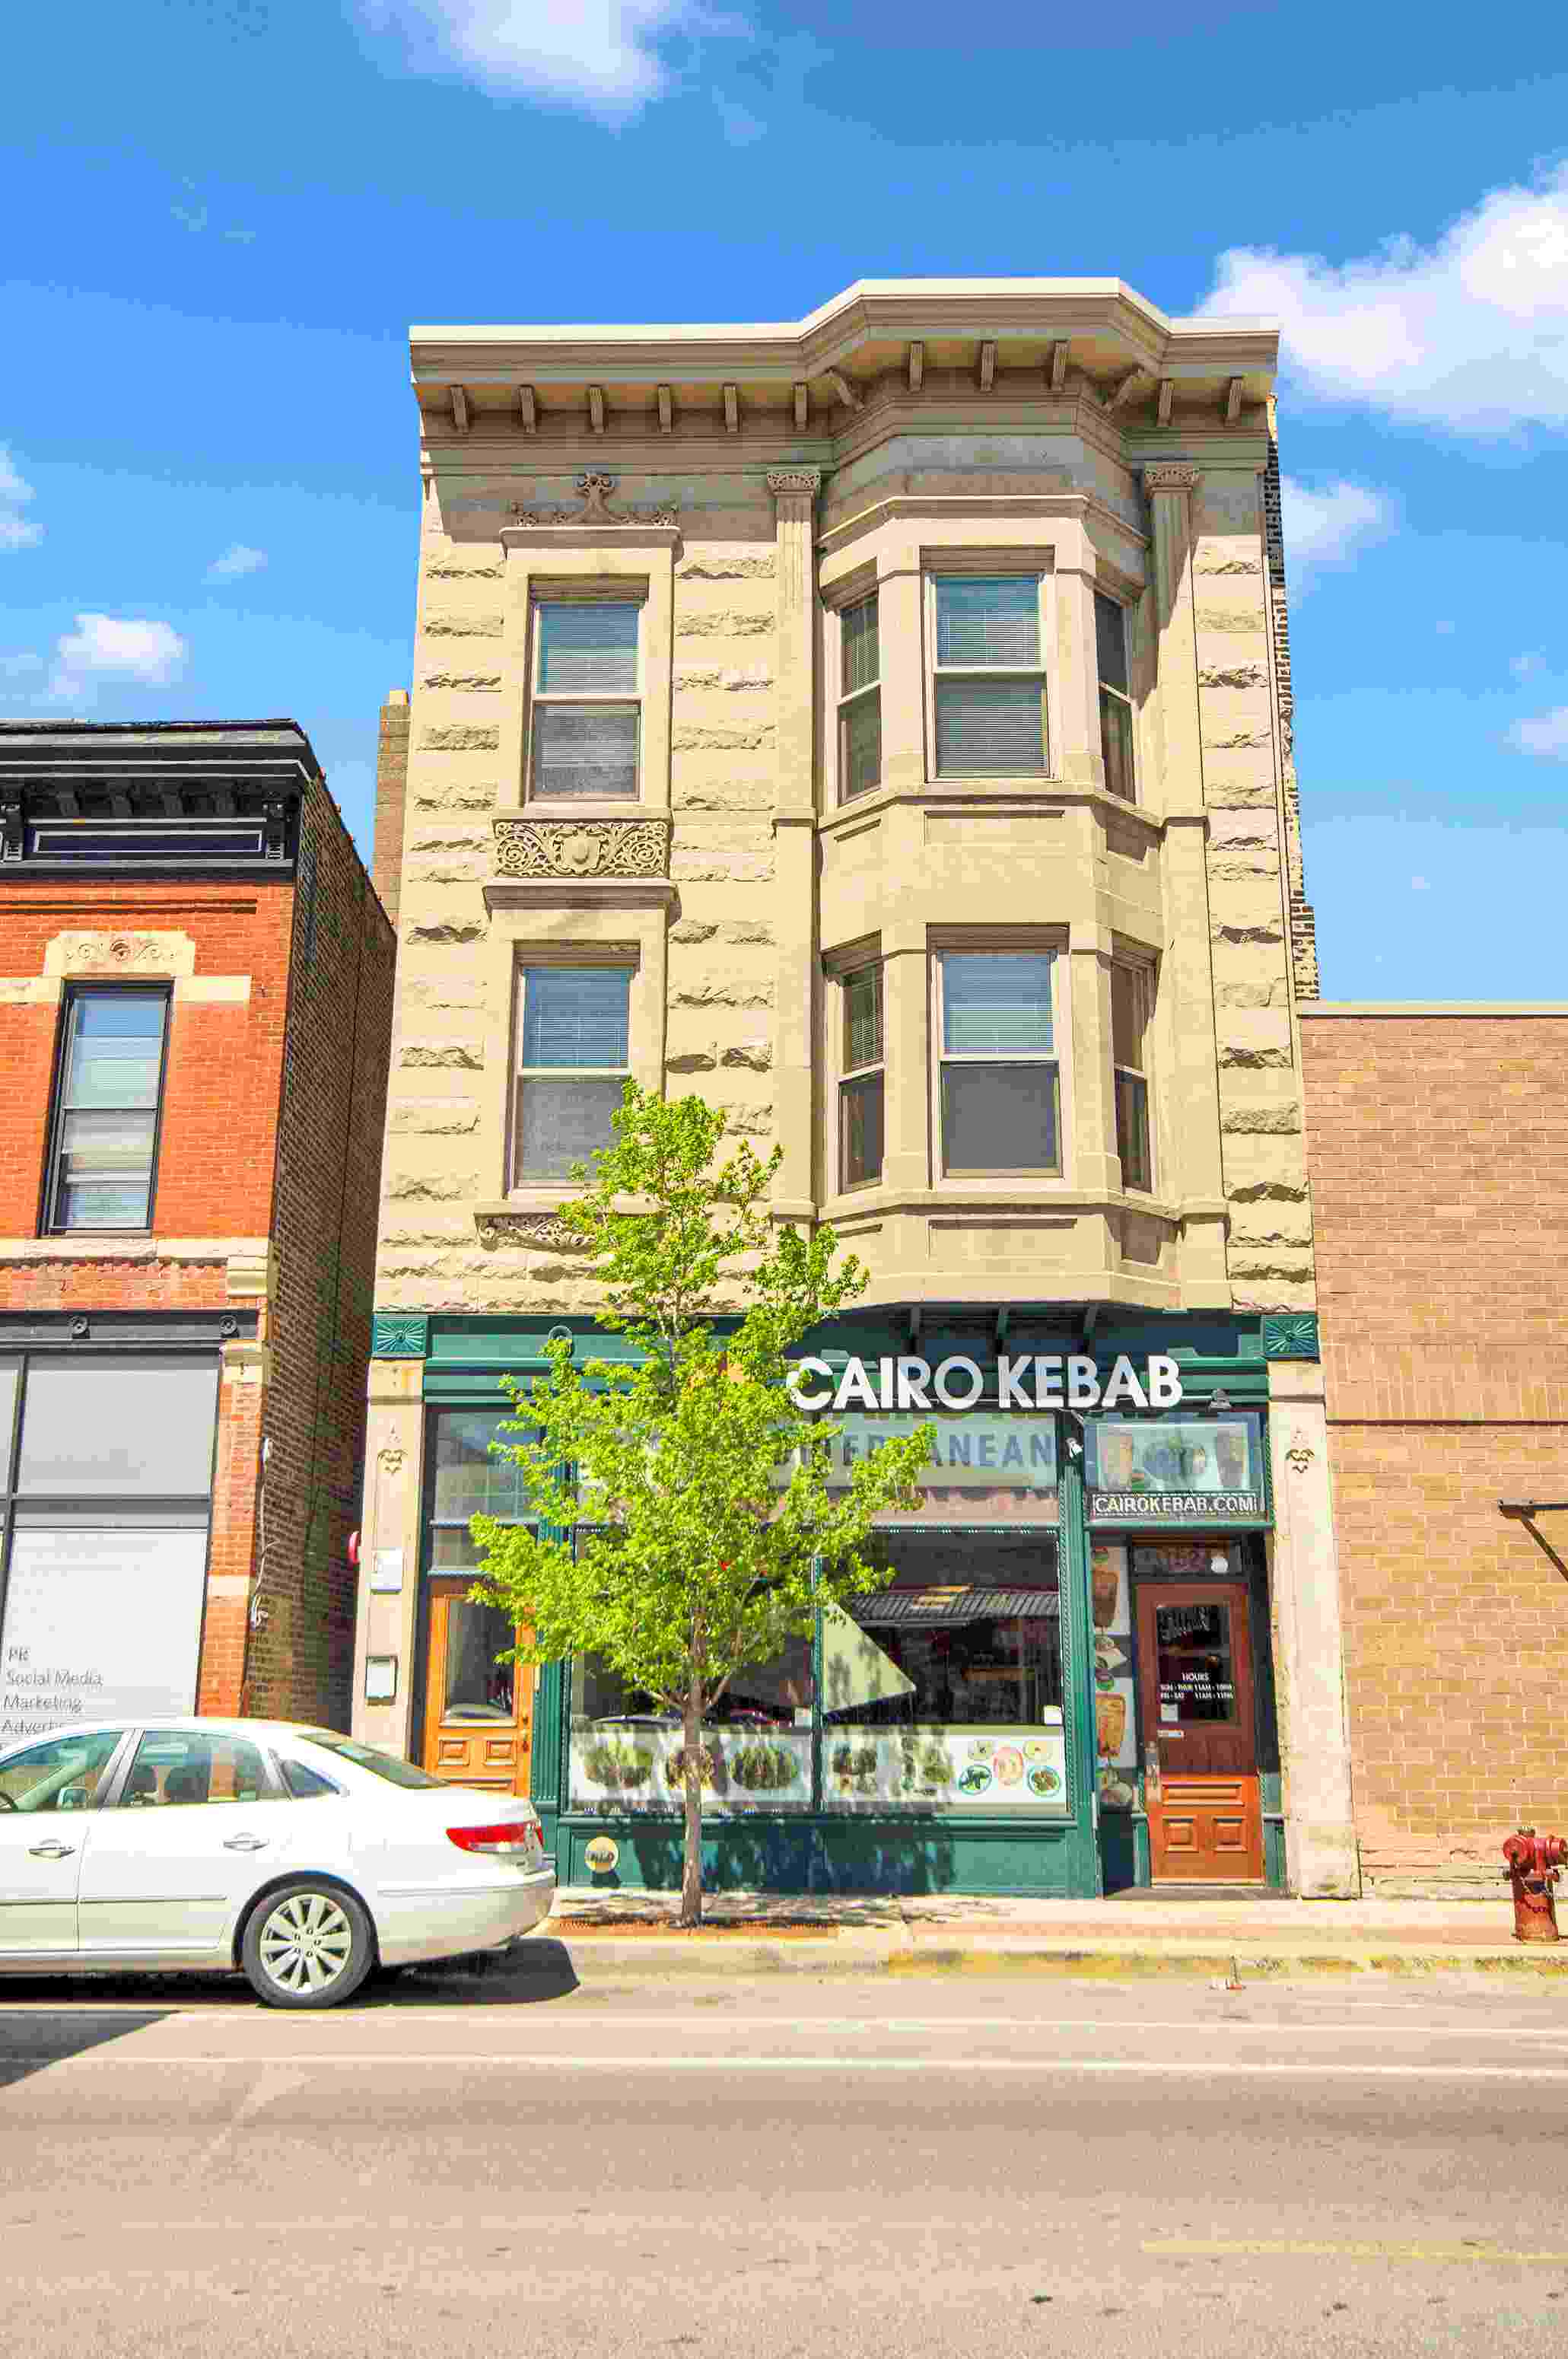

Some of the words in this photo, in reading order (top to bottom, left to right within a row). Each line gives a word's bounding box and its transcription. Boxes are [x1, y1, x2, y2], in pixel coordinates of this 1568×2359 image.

[786, 1355, 983, 1410] CAIRO
[997, 1355, 1183, 1409] KEBAB
[1095, 1497, 1254, 1512] CAIROKEBAB.COM
[6, 1670, 49, 1686] Social
[54, 1670, 103, 1686] Media
[1182, 1673, 1210, 1681] HOURS
[3, 1695, 84, 1714] Marketing
